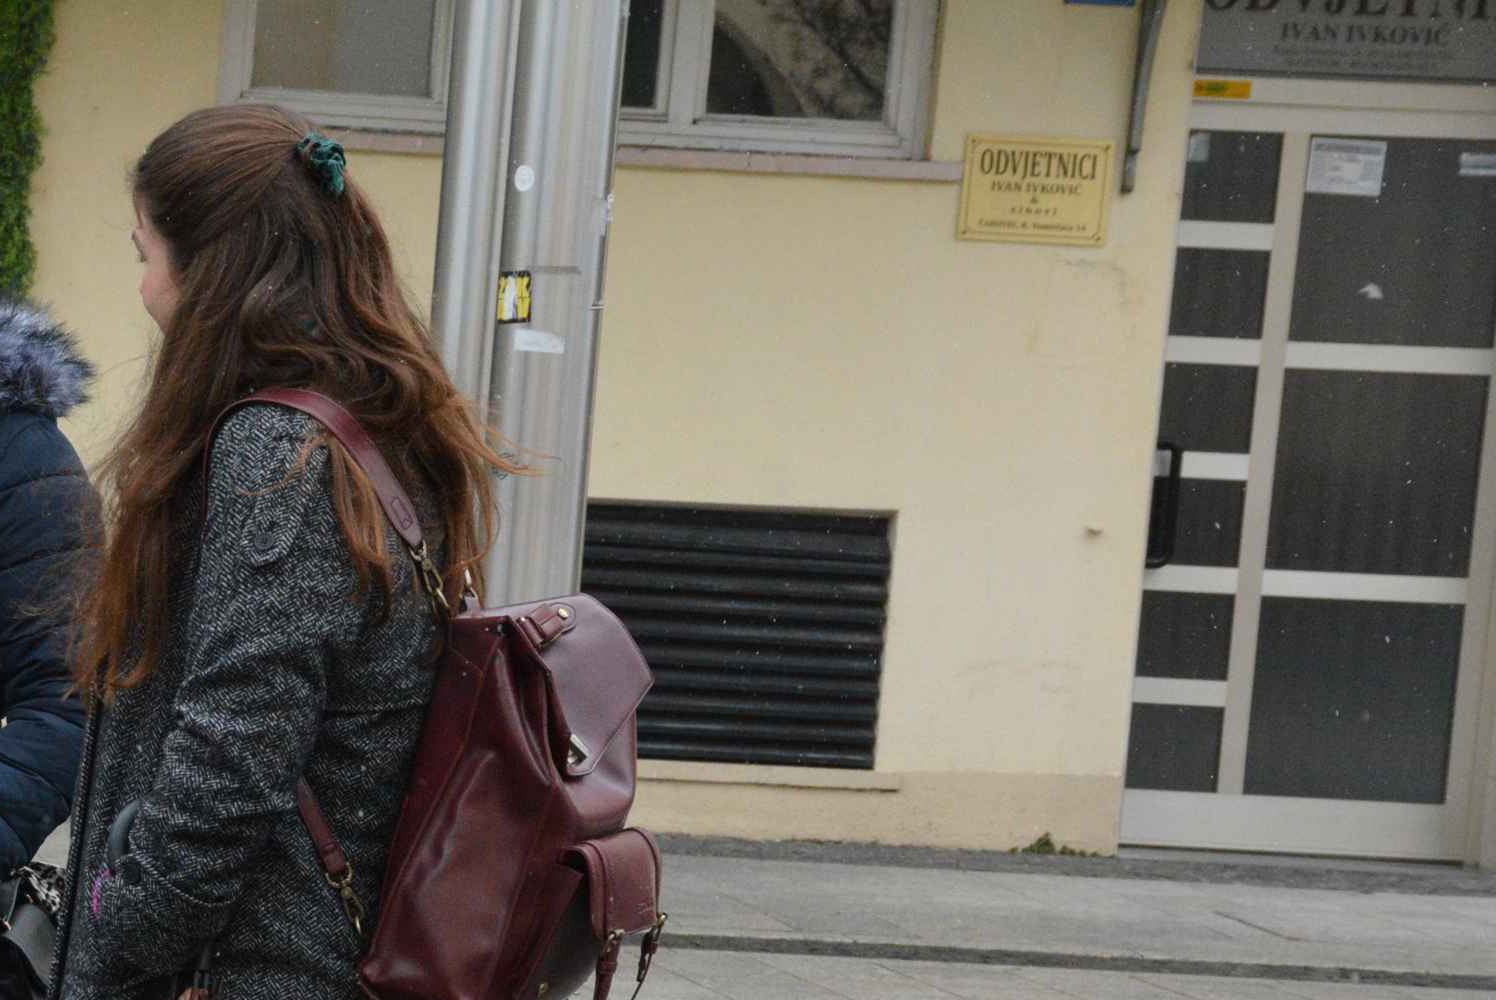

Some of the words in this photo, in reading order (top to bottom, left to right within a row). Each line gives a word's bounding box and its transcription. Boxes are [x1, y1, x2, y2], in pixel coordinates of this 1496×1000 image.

[1280, 22, 1336, 42] IVAN
[979, 148, 1099, 181] ODVJETNICI
[991, 180, 1022, 193] IVAN
